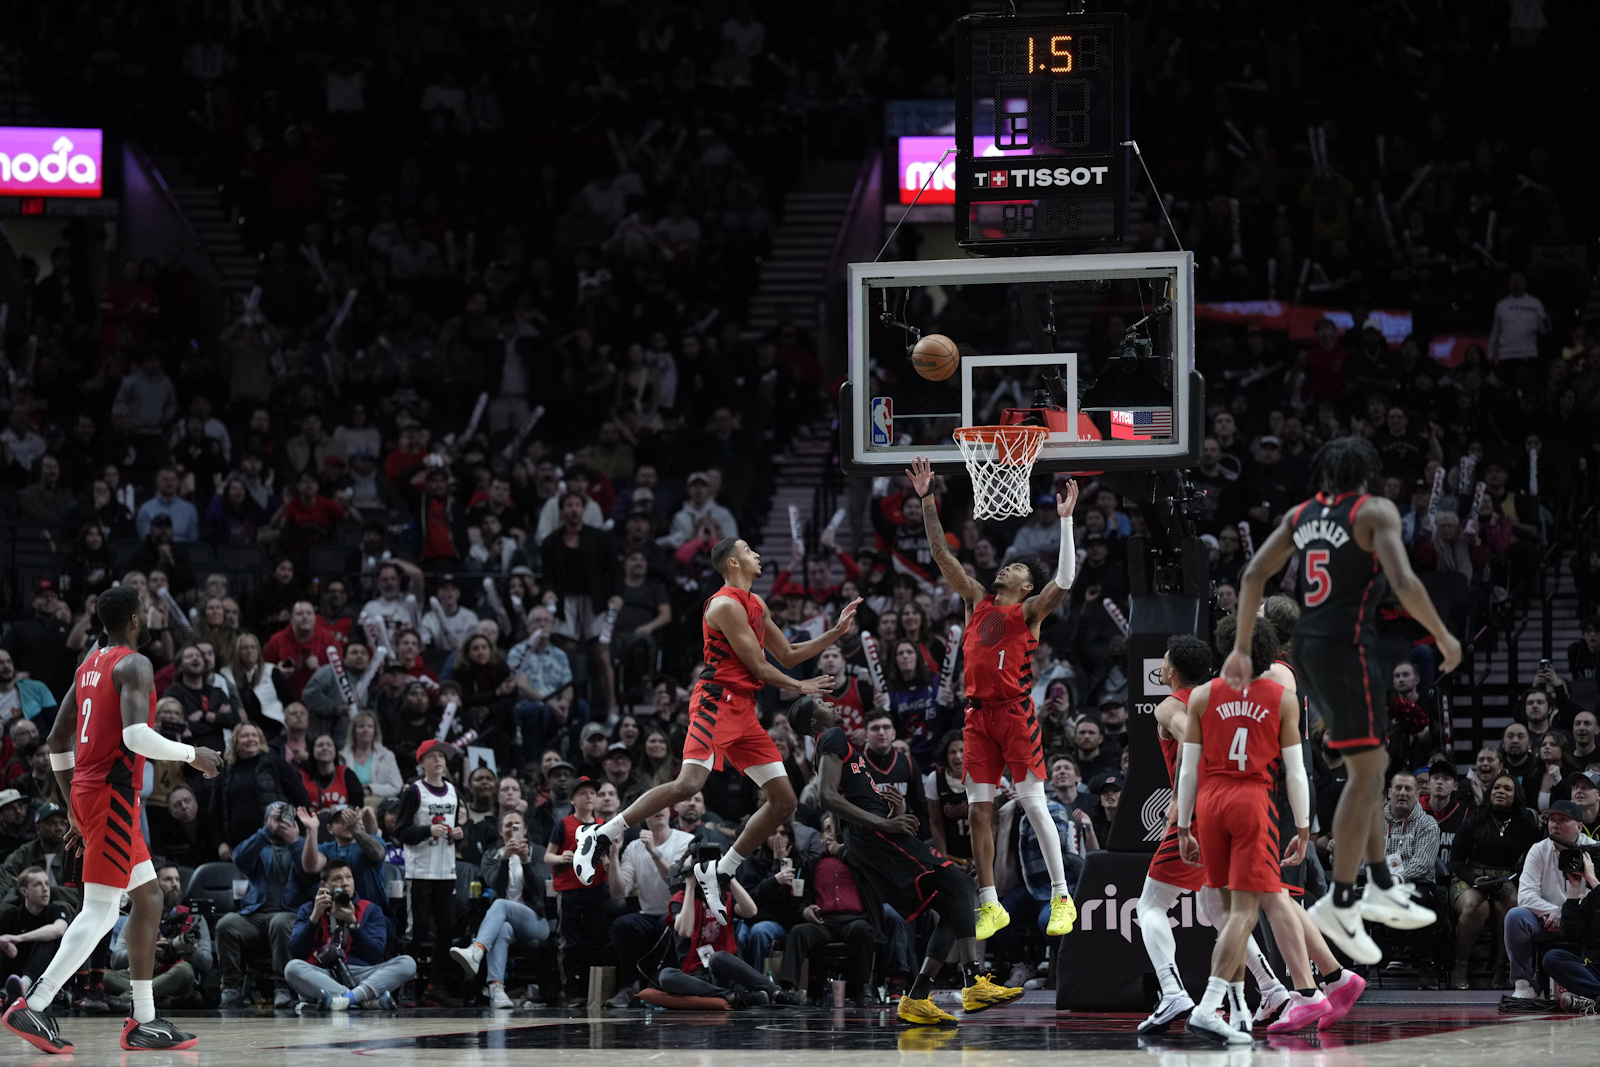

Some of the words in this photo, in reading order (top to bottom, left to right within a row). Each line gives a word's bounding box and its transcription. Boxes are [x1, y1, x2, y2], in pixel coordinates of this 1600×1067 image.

[1028, 36, 1072, 73] 1.5
[1011, 166, 1108, 188] TISSOT
[1292, 519, 1350, 550] QUICKLEY
[1304, 548, 1332, 607] 5
[998, 649, 1005, 670] 1
[80, 697, 92, 744] 2
[1215, 700, 1270, 723] THYBULLE
[1228, 727, 1248, 771] 4
